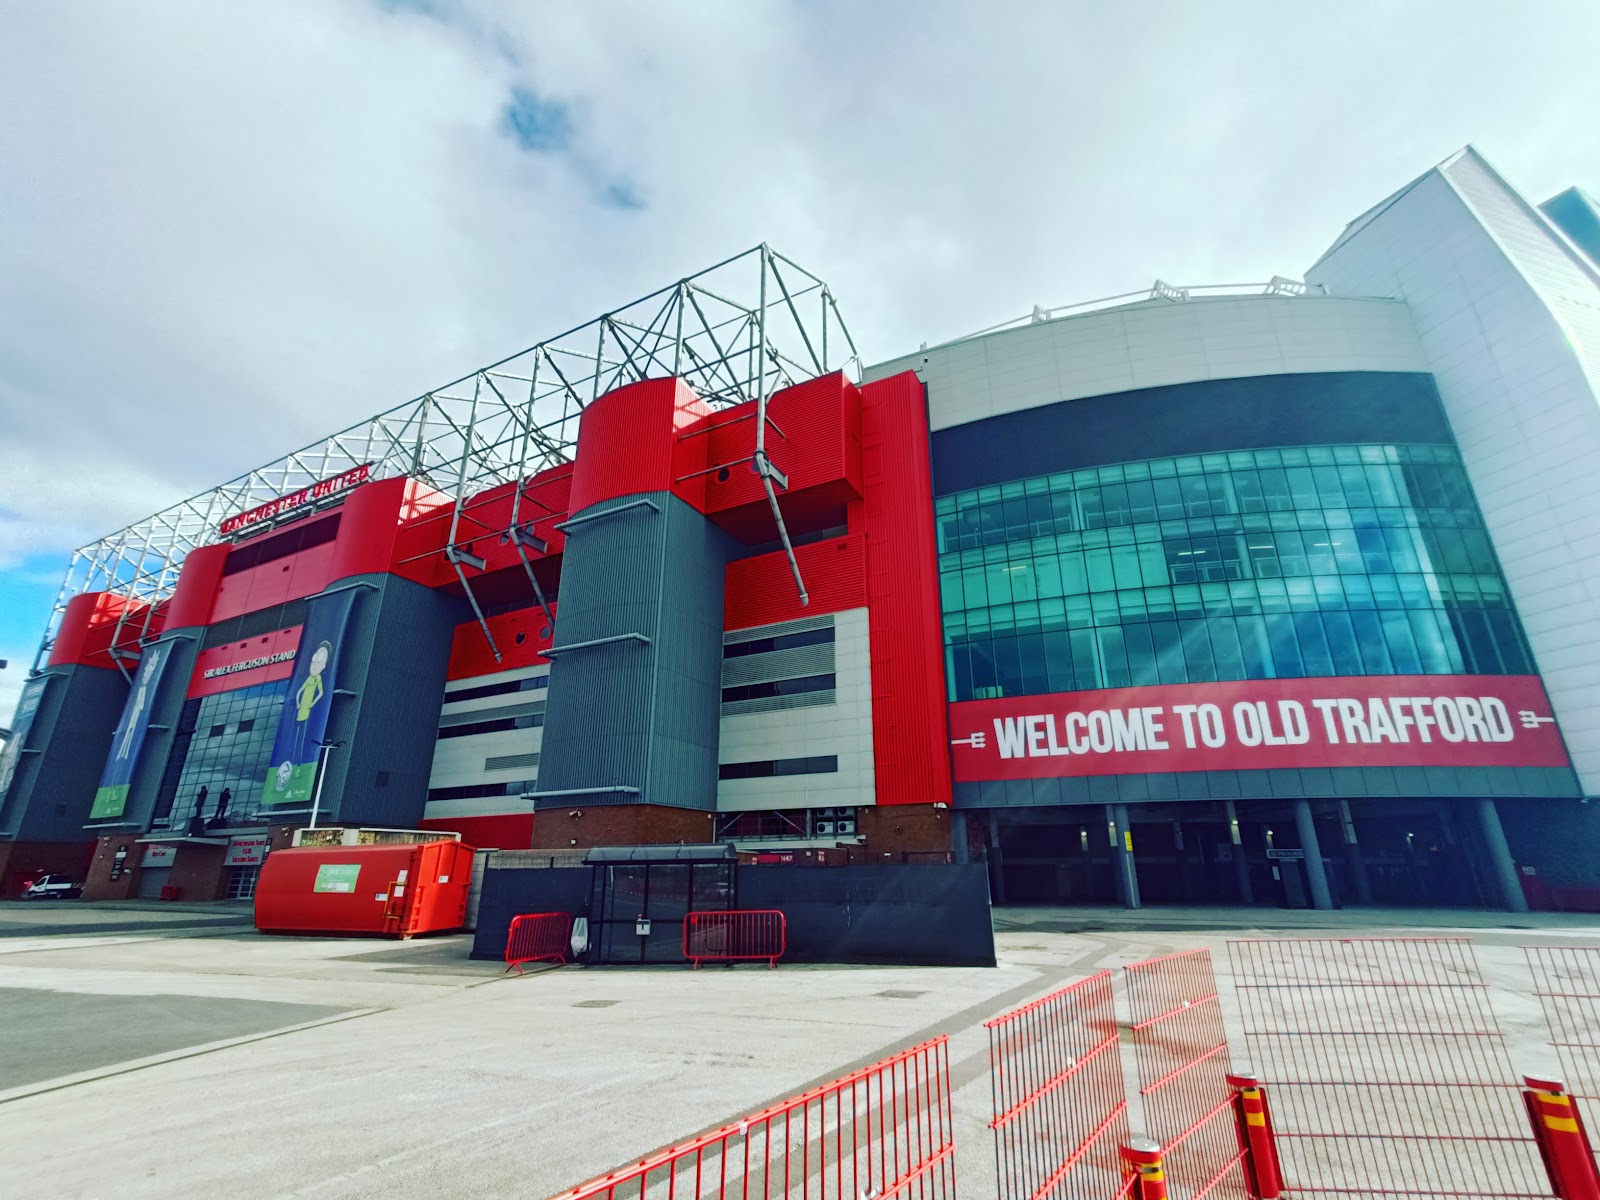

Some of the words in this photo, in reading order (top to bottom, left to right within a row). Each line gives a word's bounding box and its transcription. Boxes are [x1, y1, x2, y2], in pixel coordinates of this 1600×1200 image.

[313, 464, 371, 499] UNITED
[203, 669, 215, 678] SIR
[215, 666, 231, 677] ALEX
[231, 656, 270, 672] FERGUSON
[270, 650, 296, 663] STAND
[993, 706, 1169, 760] WELCOME
[1172, 703, 1226, 749] TO
[1233, 700, 1310, 747] OLD
[1312, 696, 1514, 744] TRAFFORD
